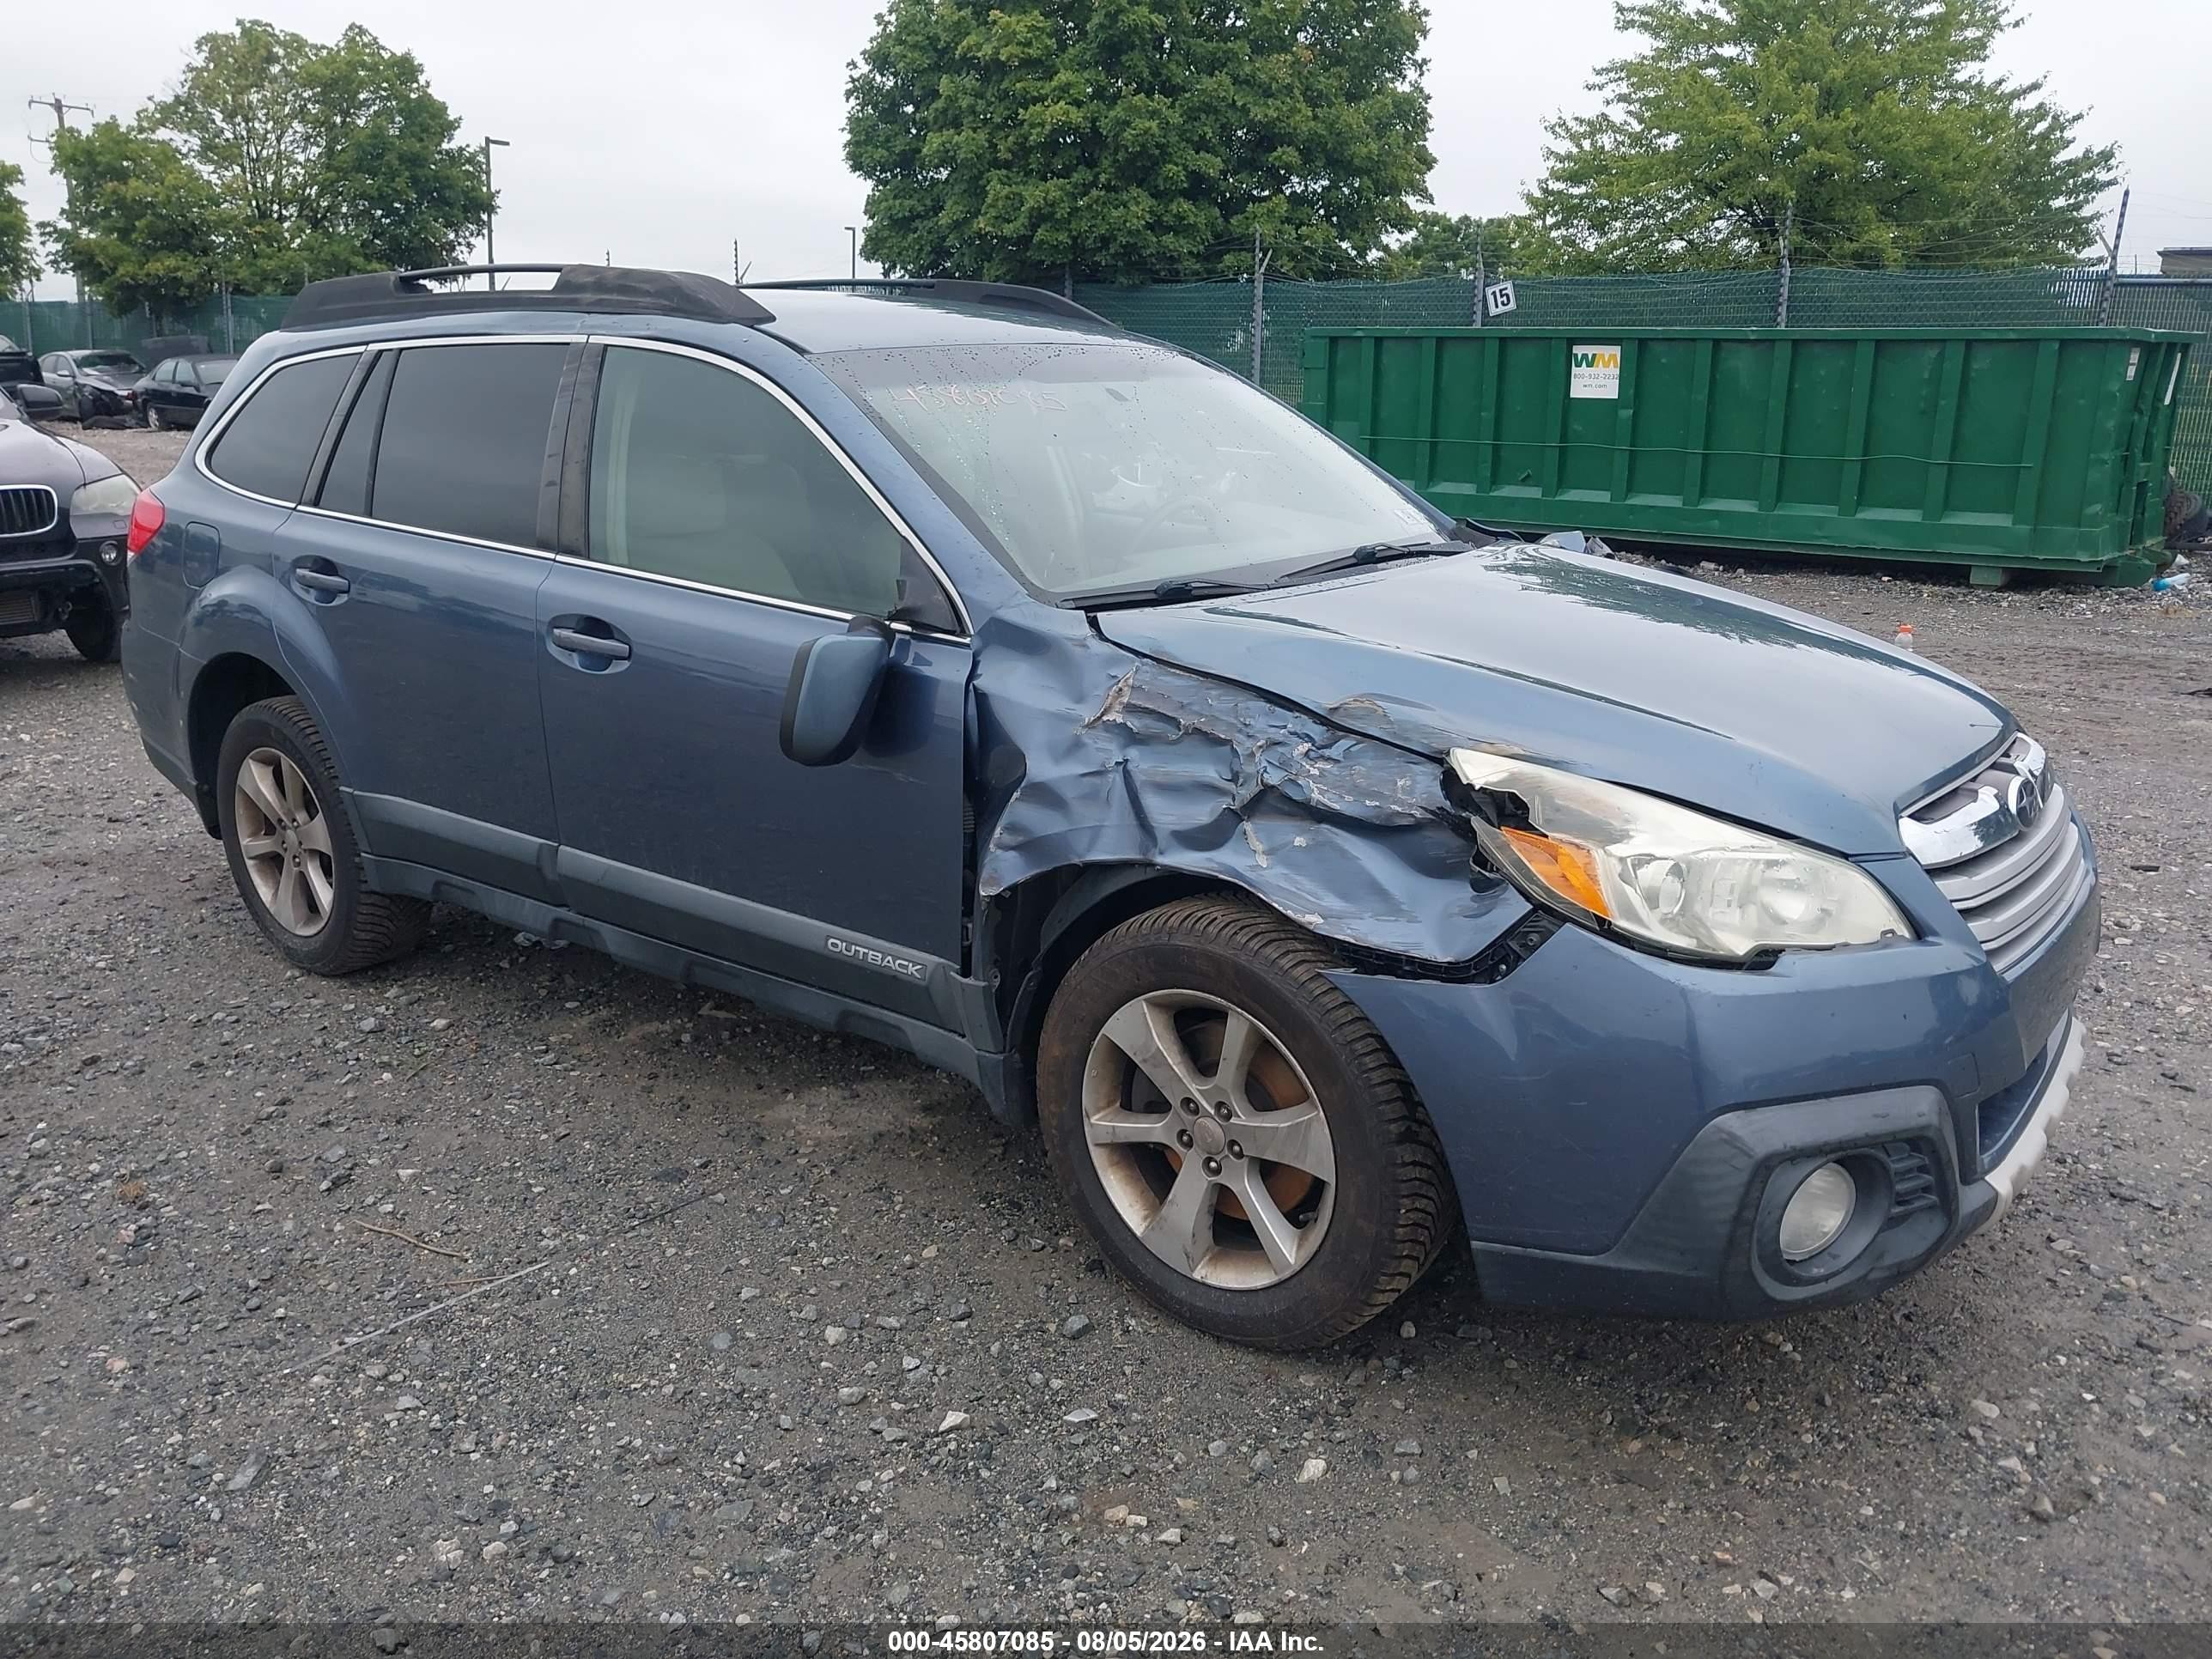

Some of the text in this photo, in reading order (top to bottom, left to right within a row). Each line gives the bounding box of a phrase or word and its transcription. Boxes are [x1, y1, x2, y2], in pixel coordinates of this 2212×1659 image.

[1491, 287, 1510, 308] 15
[1572, 353, 1619, 368] WM
[827, 938, 923, 978] OUTBACK
